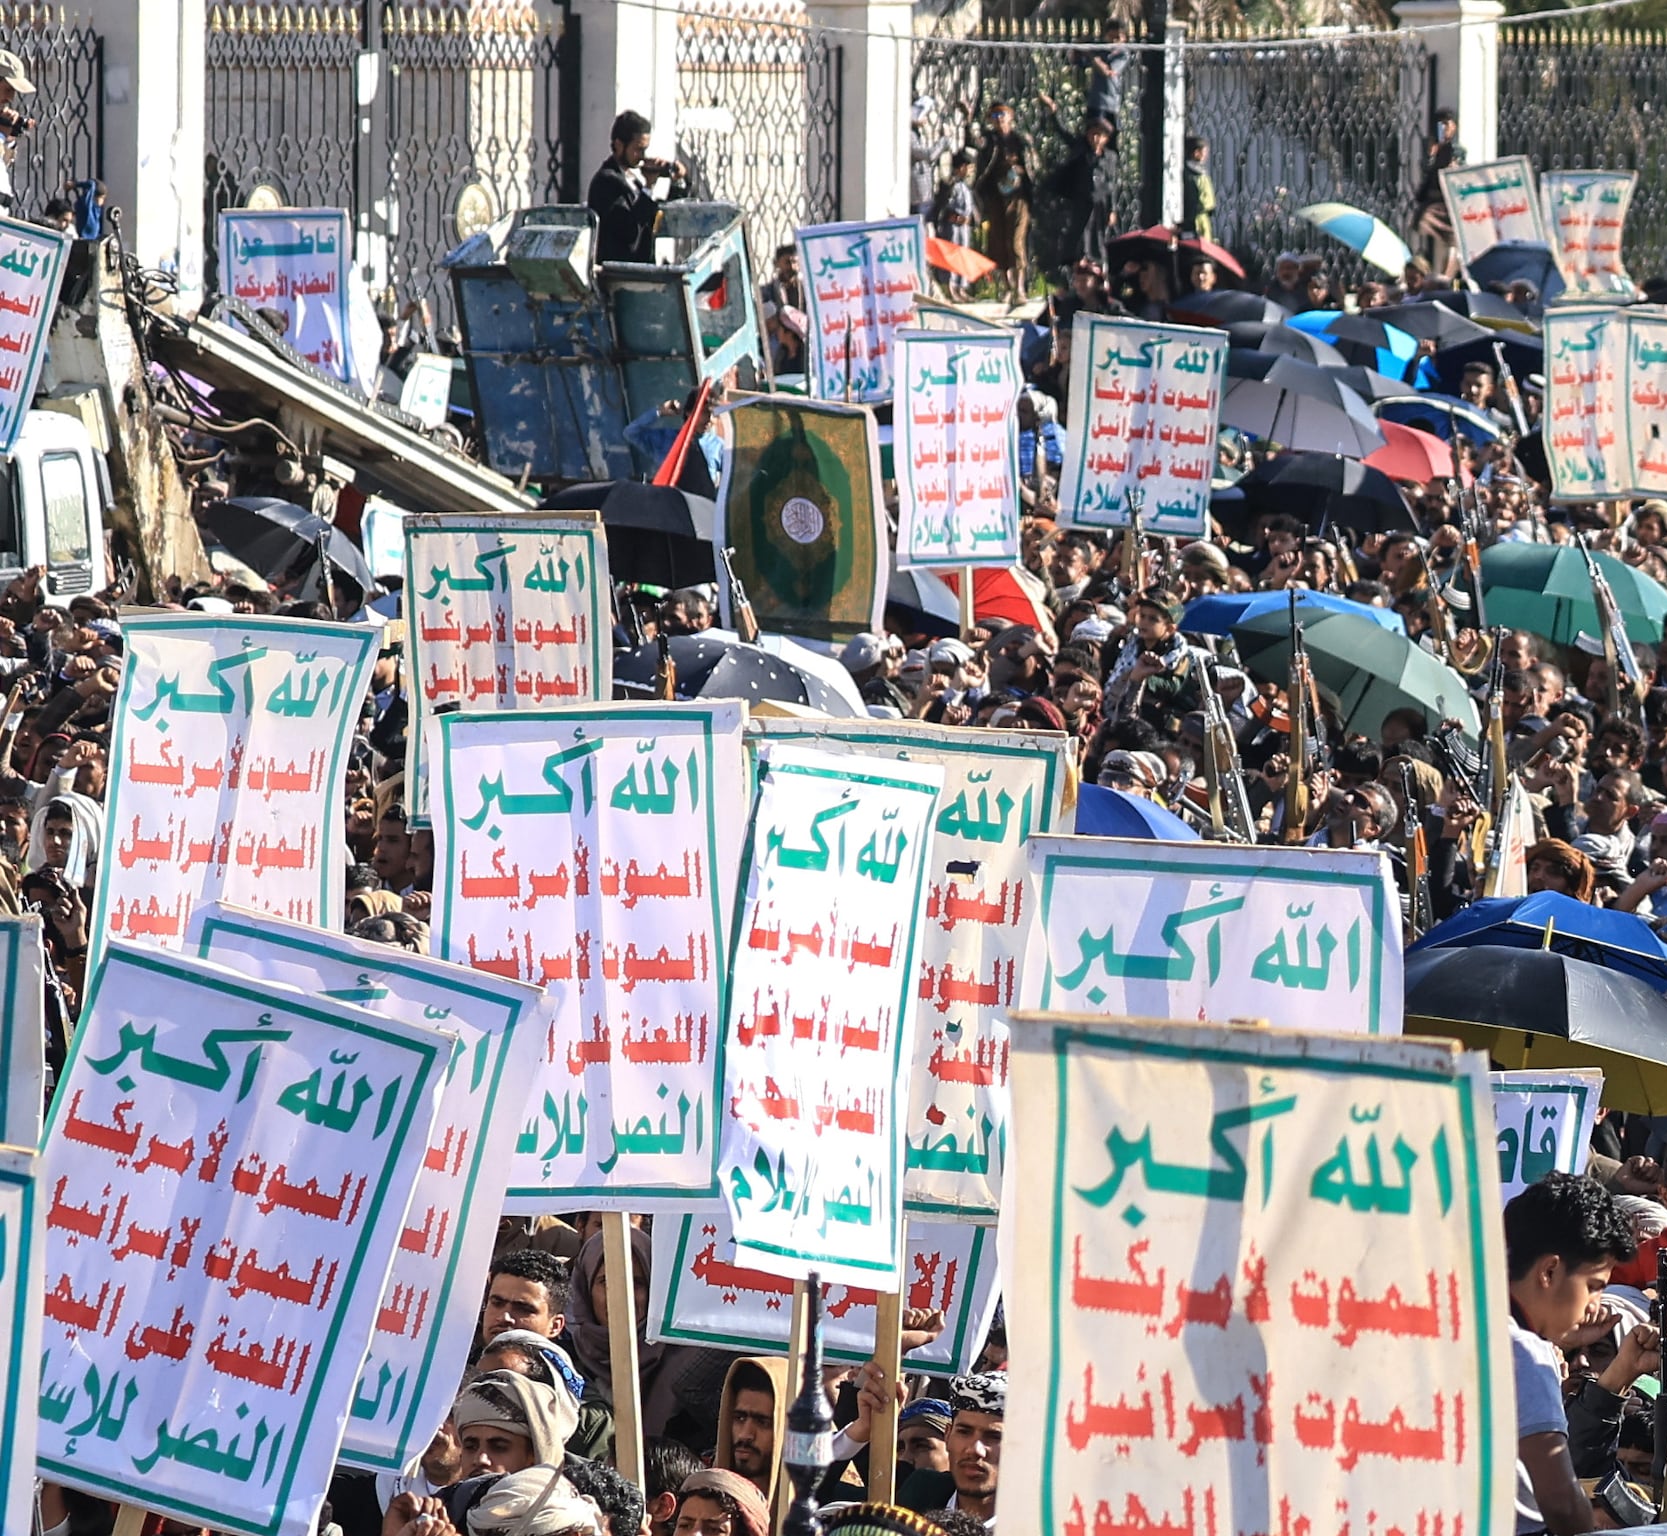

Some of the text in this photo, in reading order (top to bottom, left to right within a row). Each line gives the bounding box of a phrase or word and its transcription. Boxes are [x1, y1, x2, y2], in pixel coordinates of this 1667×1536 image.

[0, 240, 50, 280] الله
[230, 224, 336, 266] قاطعوا
[812, 227, 915, 279] الله أكبر
[234, 272, 336, 302] البضائع الأمريكية
[912, 351, 1015, 396] الله أكبر
[1099, 327, 1221, 375] الله أكبر
[1094, 378, 1216, 413] الموت لأمريكا
[1090, 412, 1214, 449] الموت لإسرائيل
[1085, 451, 1211, 482] اللعنة على اليهود
[969, 510, 1014, 551] النصر
[422, 540, 587, 605] الله أكبر
[420, 610, 586, 651] الموت لأمريكا
[133, 638, 347, 732] الله أكبر
[424, 661, 588, 703] الموت لإسرائيل
[129, 738, 325, 800] الموت لأمريكا
[463, 729, 699, 839] الله أكبر
[937, 775, 1032, 844] الله
[118, 816, 316, 878] الموت لإسرائيل
[460, 834, 702, 911] الموت لأمريكا
[109, 895, 191, 945] اليهود
[1056, 883, 1361, 1005] الله أكبر
[602, 934, 708, 993] الموت
[566, 1013, 707, 1076] اللعنة على
[87, 1013, 403, 1140] الله أكبر
[63, 1091, 365, 1221] الموت لأمريكا
[598, 1085, 703, 1173] النصر
[1077, 1086, 1453, 1227] الله أكبر
[205, 1240, 336, 1307] الموت
[1070, 1233, 1463, 1349] الموت لأمريكا
[123, 1304, 309, 1391] اللعنة على
[131, 1403, 287, 1488] النصر
[1064, 1360, 1467, 1473] الموت لإسرائيل
